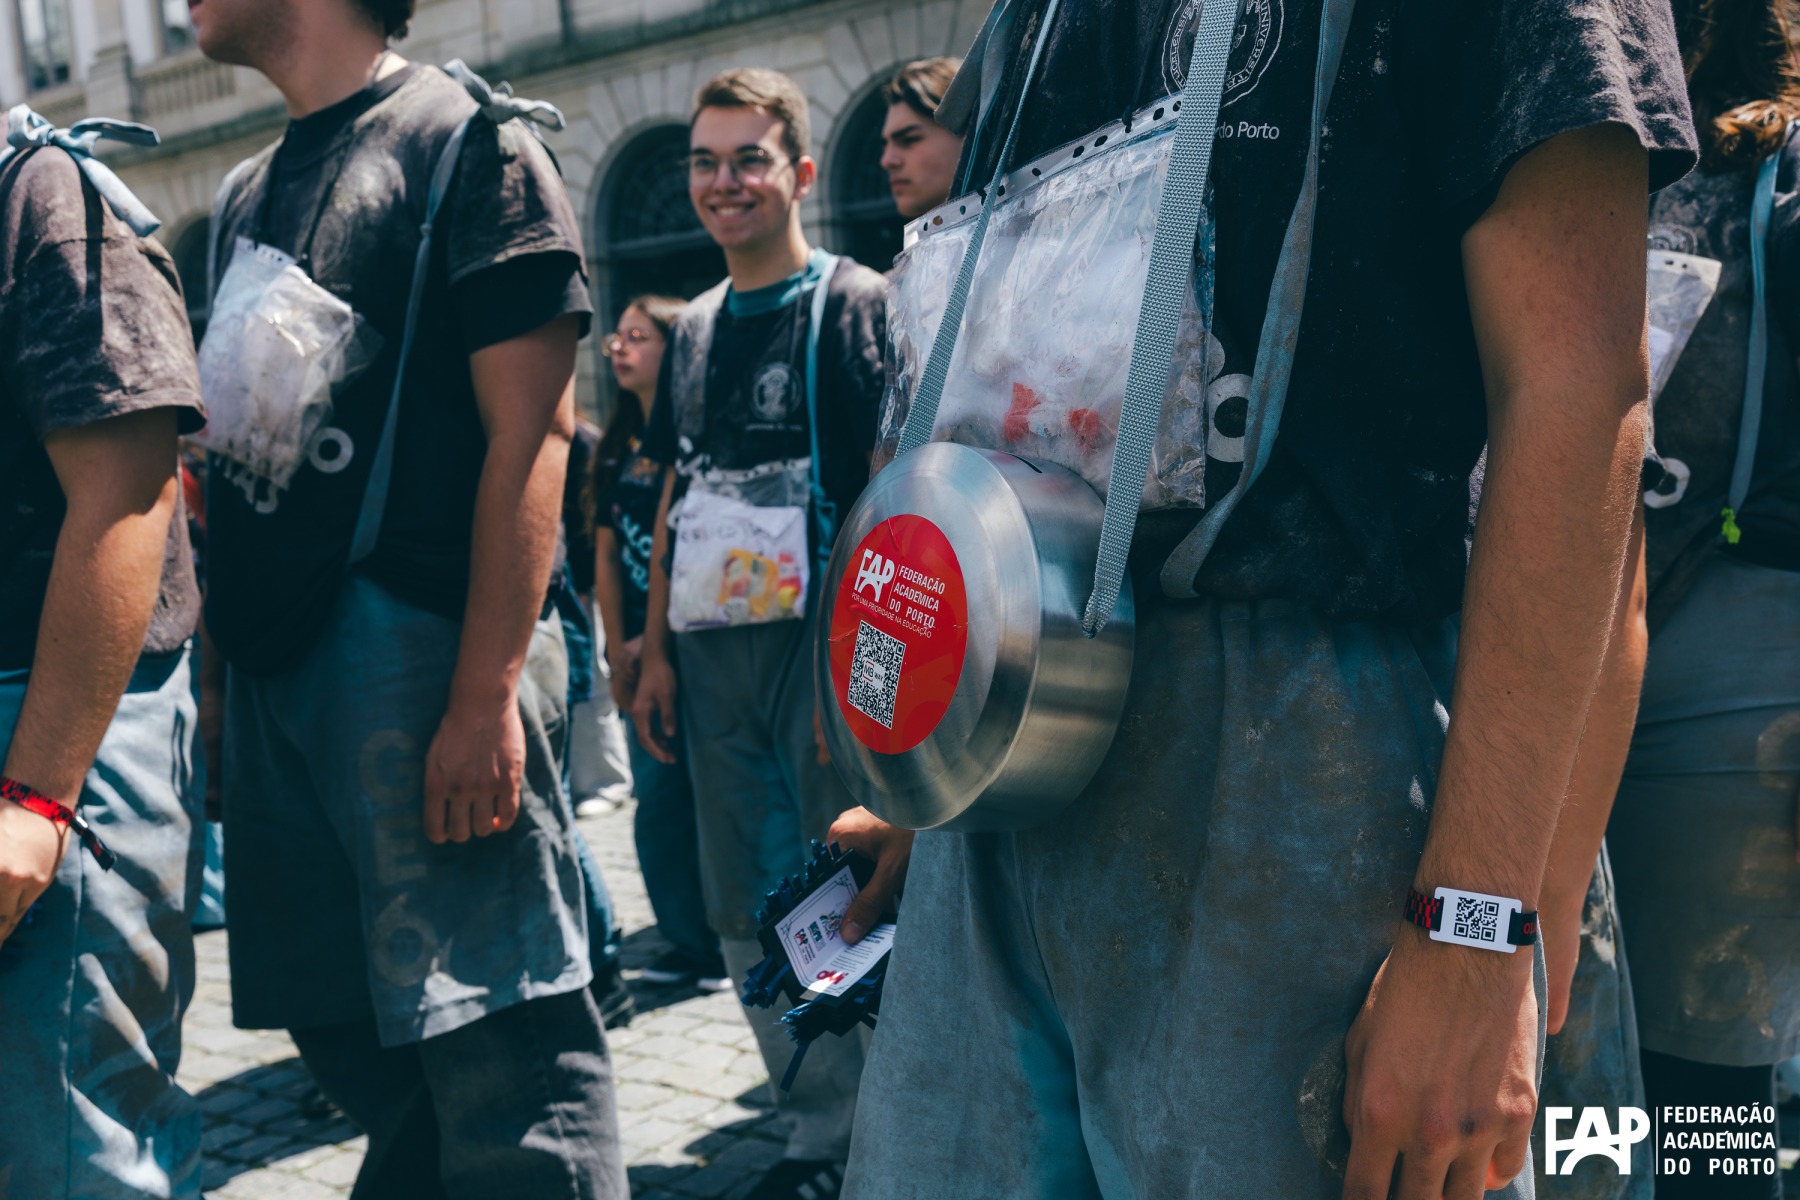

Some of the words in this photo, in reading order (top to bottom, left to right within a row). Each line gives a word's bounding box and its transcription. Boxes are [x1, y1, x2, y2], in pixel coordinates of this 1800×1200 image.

[1237, 121, 1280, 140] Porto
[854, 548, 895, 603] FAP
[899, 565, 946, 595] FEDERAÇÃO
[868, 602, 895, 621] PRIORIDADE
[895, 615, 902, 625] NA
[902, 619, 932, 639] EDUCAÇÃO
[889, 598, 901, 613] DO
[905, 606, 935, 629] PORTO
